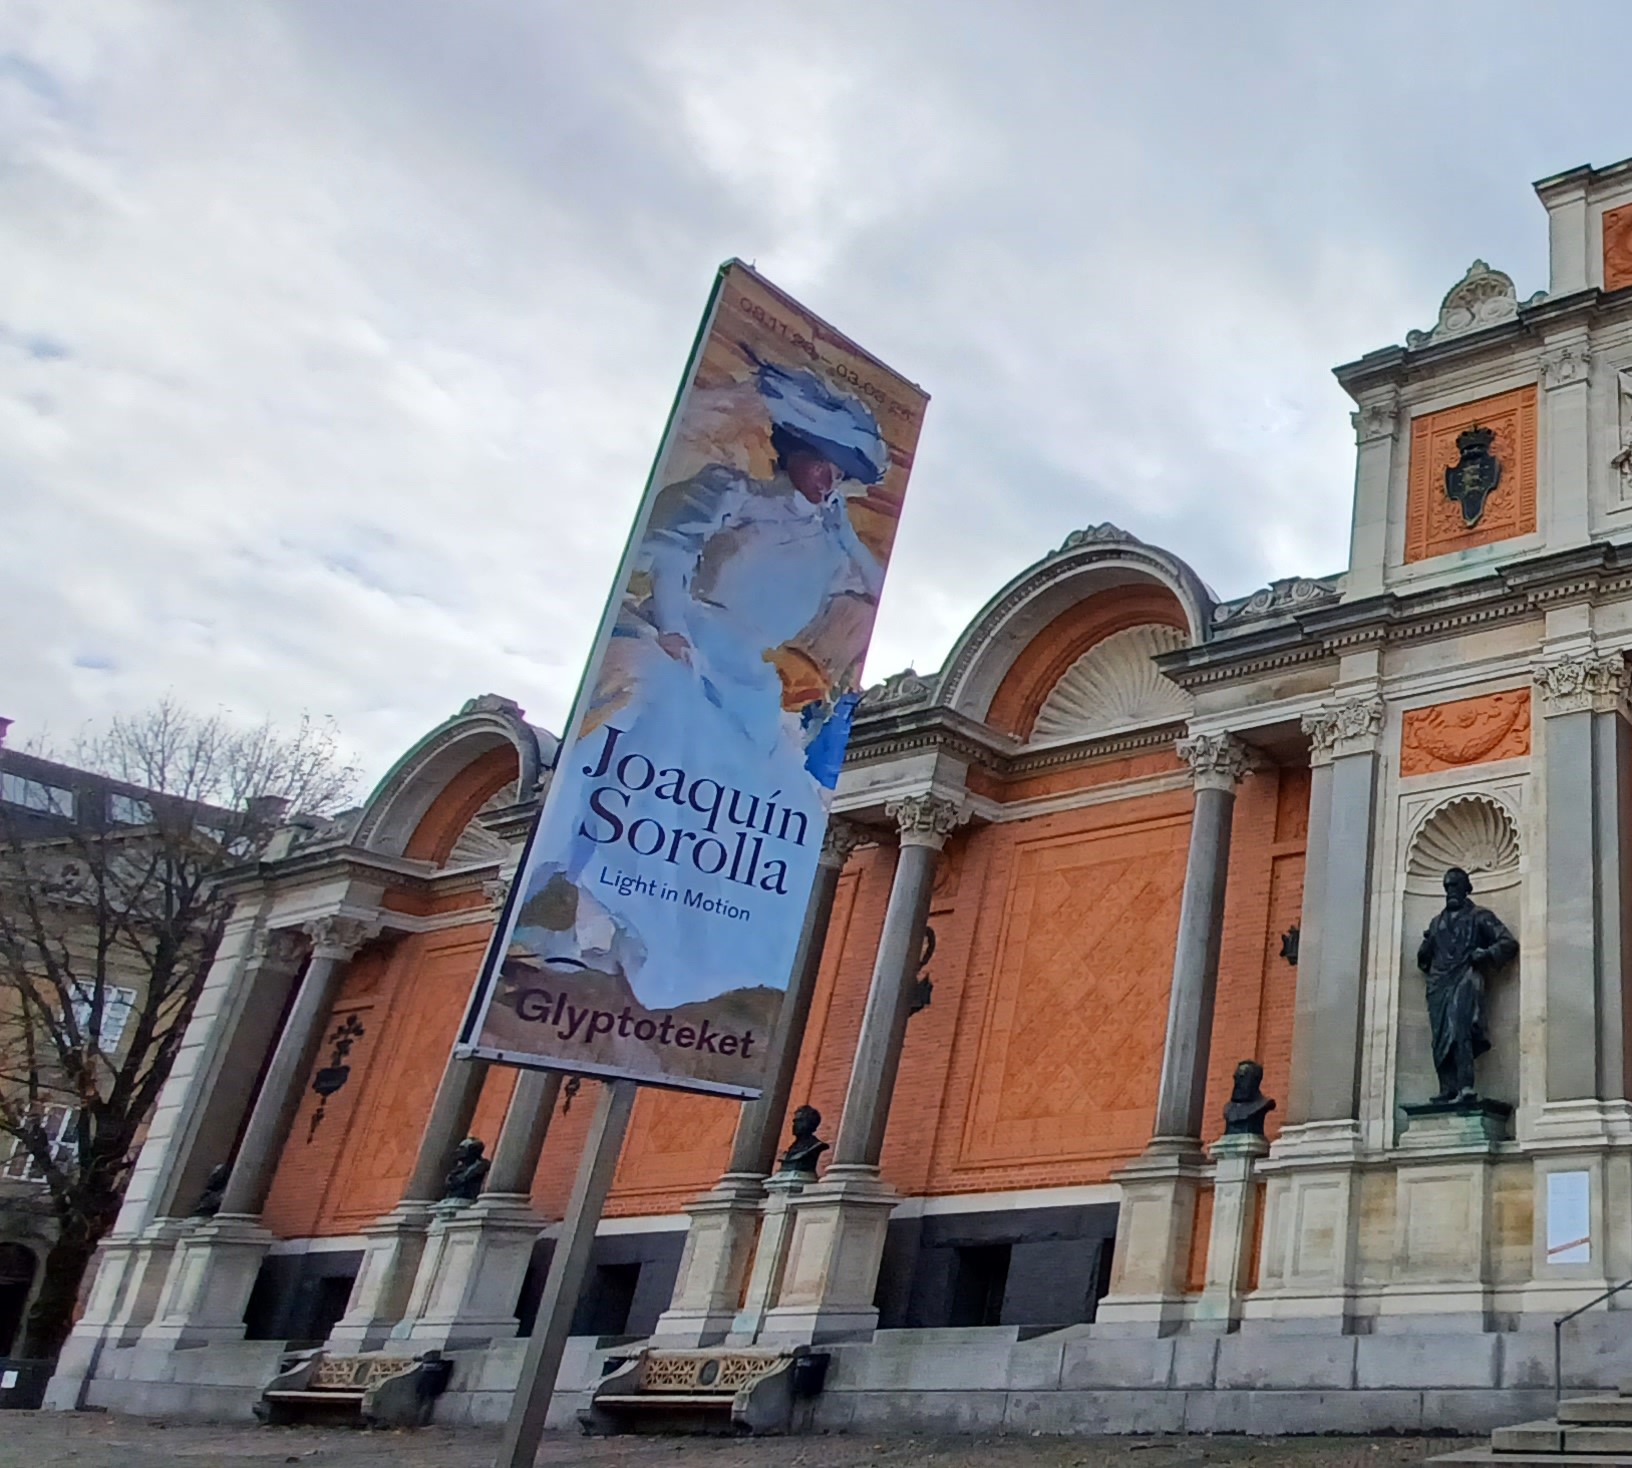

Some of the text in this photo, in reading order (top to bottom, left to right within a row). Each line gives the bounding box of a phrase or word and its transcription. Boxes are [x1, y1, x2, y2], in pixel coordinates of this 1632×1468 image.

[582, 724, 808, 847] Joaquín
[578, 786, 788, 895] Sorolla
[600, 866, 750, 921] Light in Motion
[516, 988, 755, 1058] Glyptoteket
